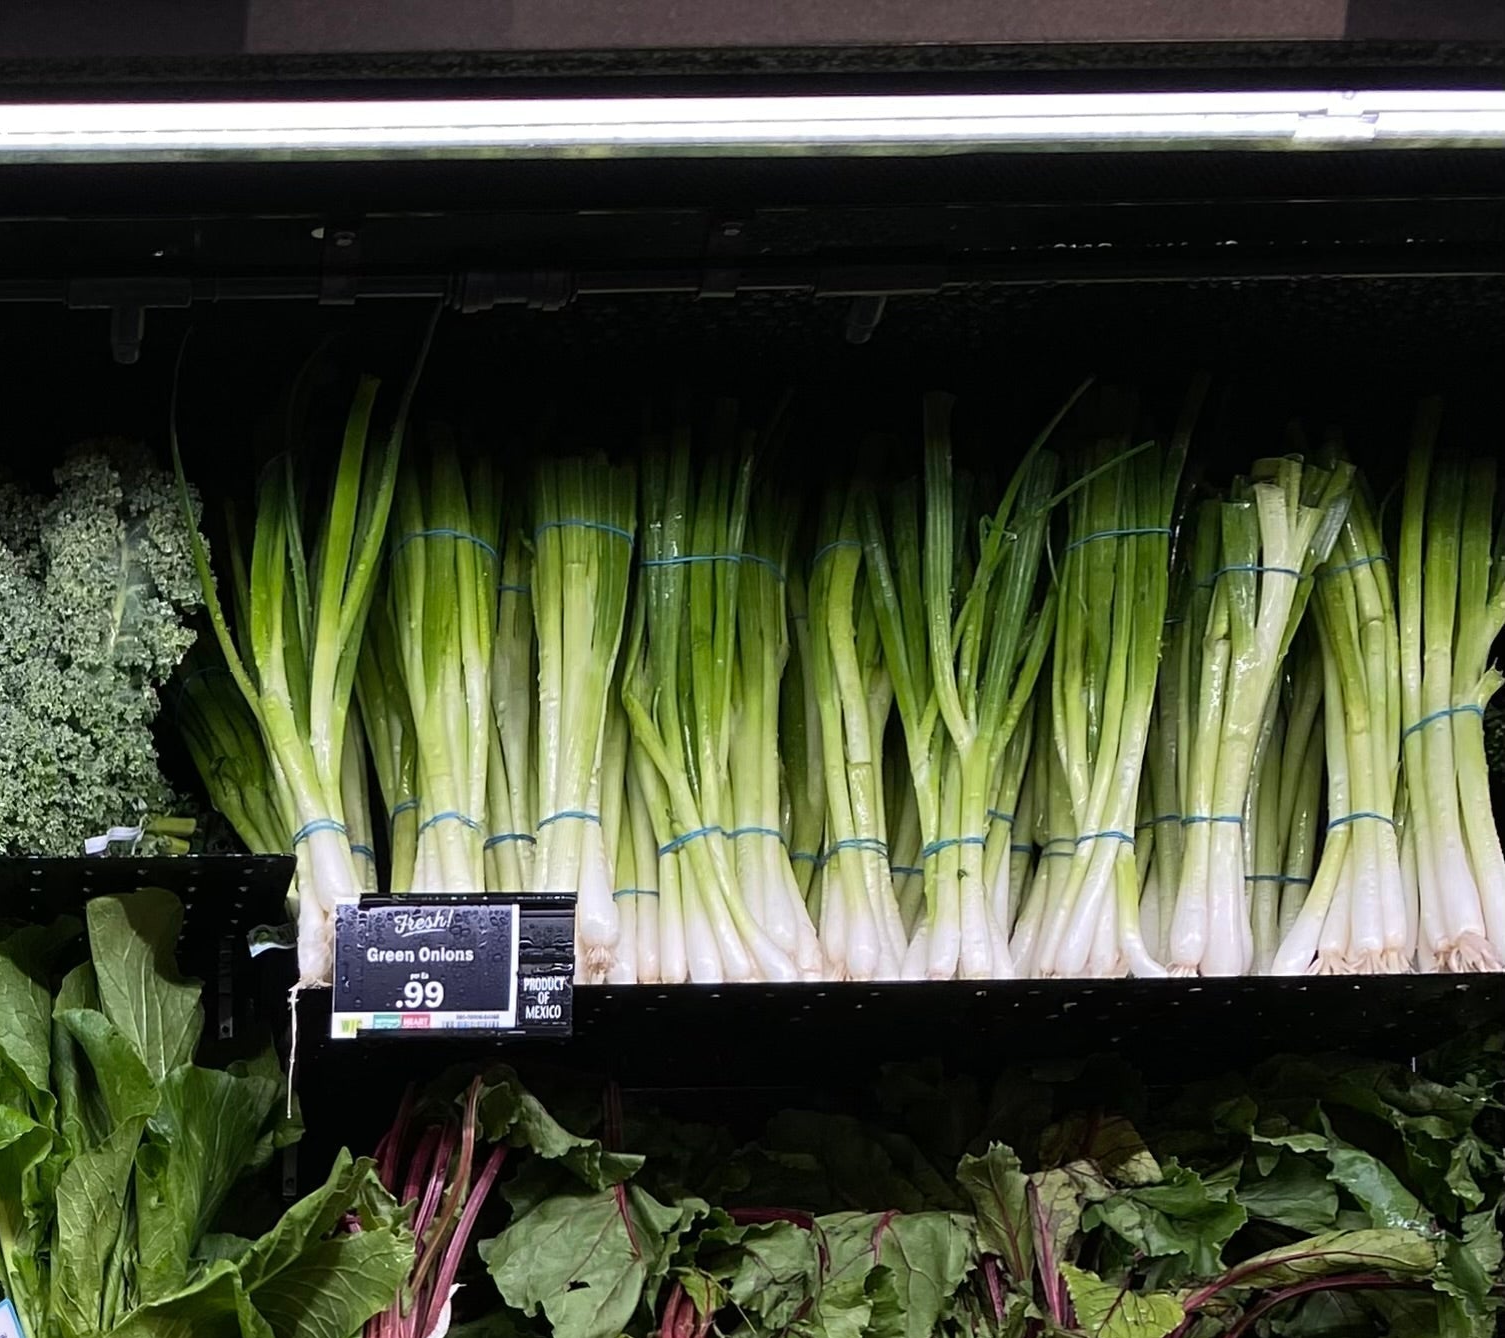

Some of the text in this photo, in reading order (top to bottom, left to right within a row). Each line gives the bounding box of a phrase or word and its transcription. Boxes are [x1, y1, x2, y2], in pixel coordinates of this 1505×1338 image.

[394, 910, 454, 933] Fresh!
[367, 947, 474, 962] Green Onions
[523, 977, 565, 991] PRODUCT
[395, 981, 444, 1008] .99
[537, 991, 550, 1004] OF
[525, 1004, 562, 1019] MEXICO
